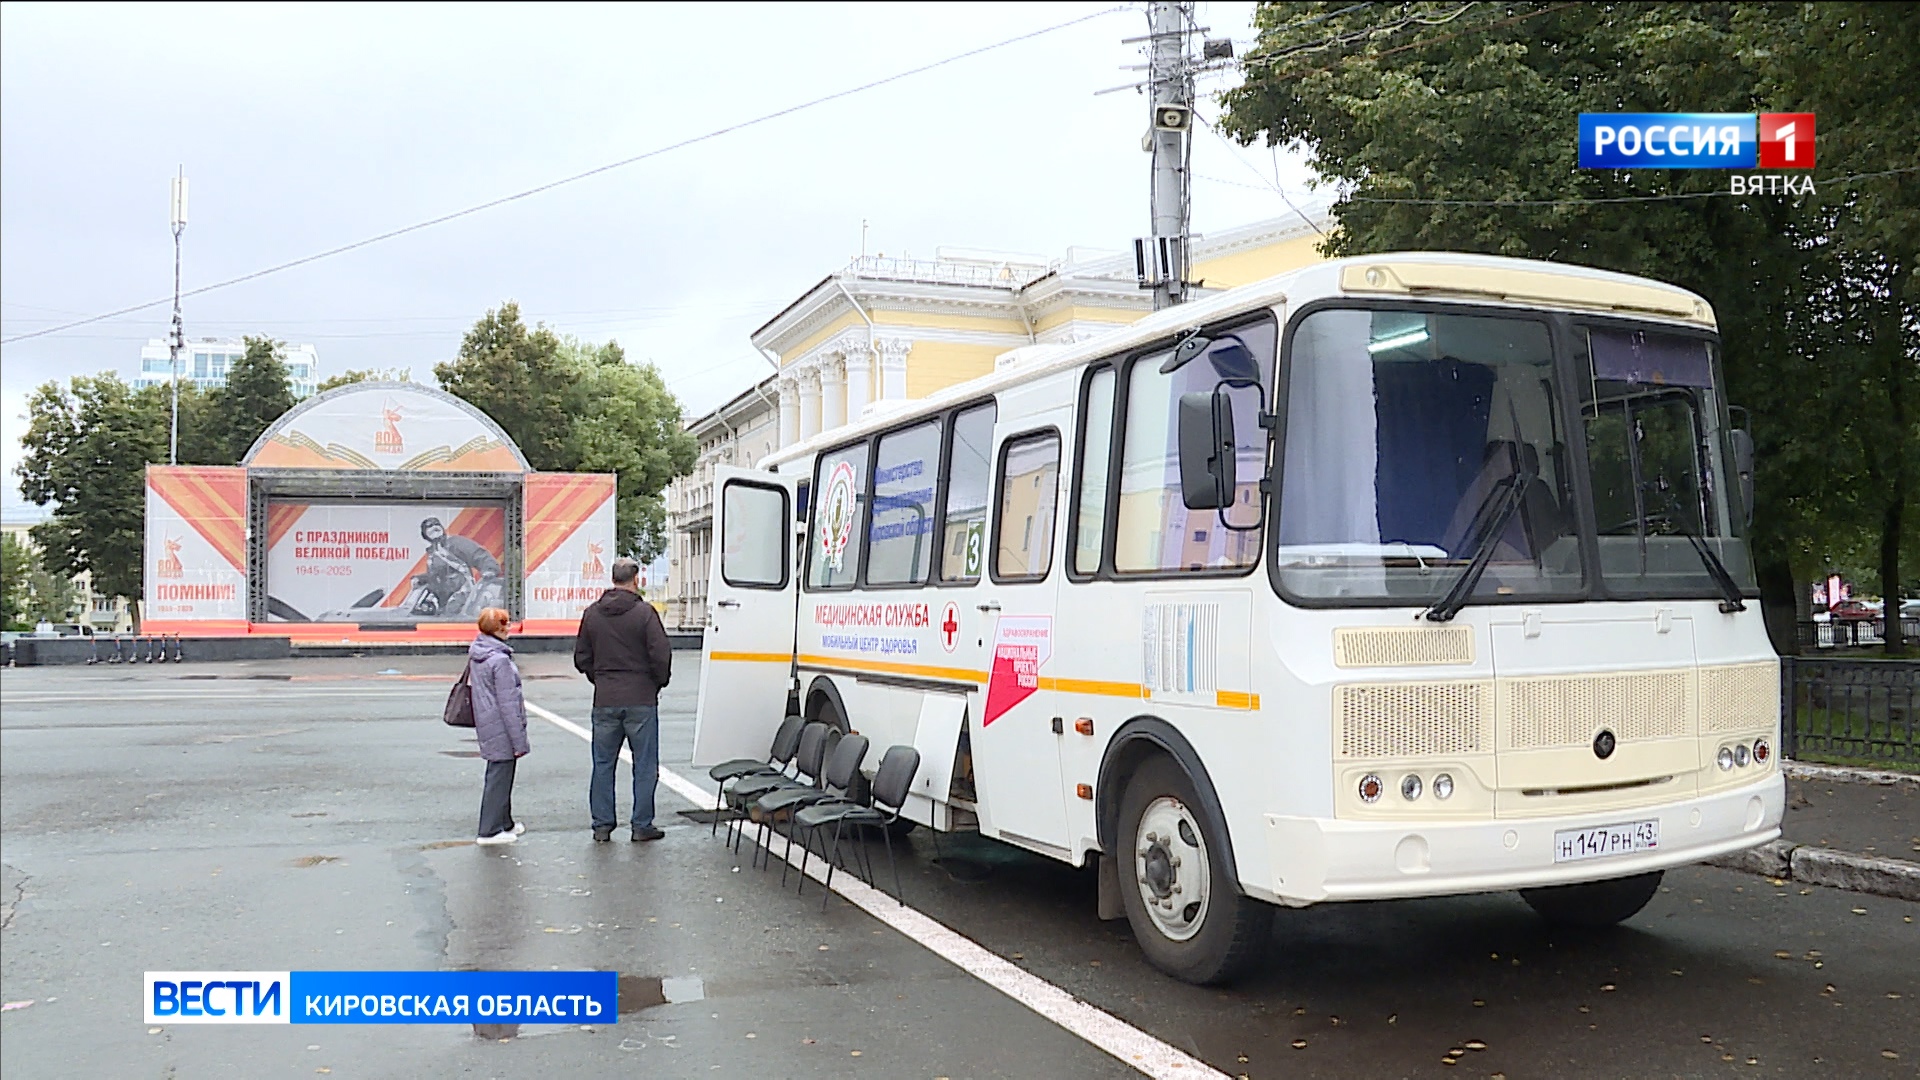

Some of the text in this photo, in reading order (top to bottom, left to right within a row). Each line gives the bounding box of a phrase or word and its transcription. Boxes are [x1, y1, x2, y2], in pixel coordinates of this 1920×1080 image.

[295, 531, 389, 545] С ПРАЗДНИКОМ
[295, 544, 410, 561] ВЕЛИКОЙ ПОБЕДЫ!
[968, 532, 980, 572] 3
[157, 584, 236, 600] ПОМНИМ!
[534, 587, 607, 603] ГОРДИМСЯ
[815, 603, 929, 629] МЕДИЦИНСКАЯ СЛУЖБА
[822, 633, 917, 655] МОБИЛЬНЫЙ ЦЕНТР ЗДОРОВЬЯ
